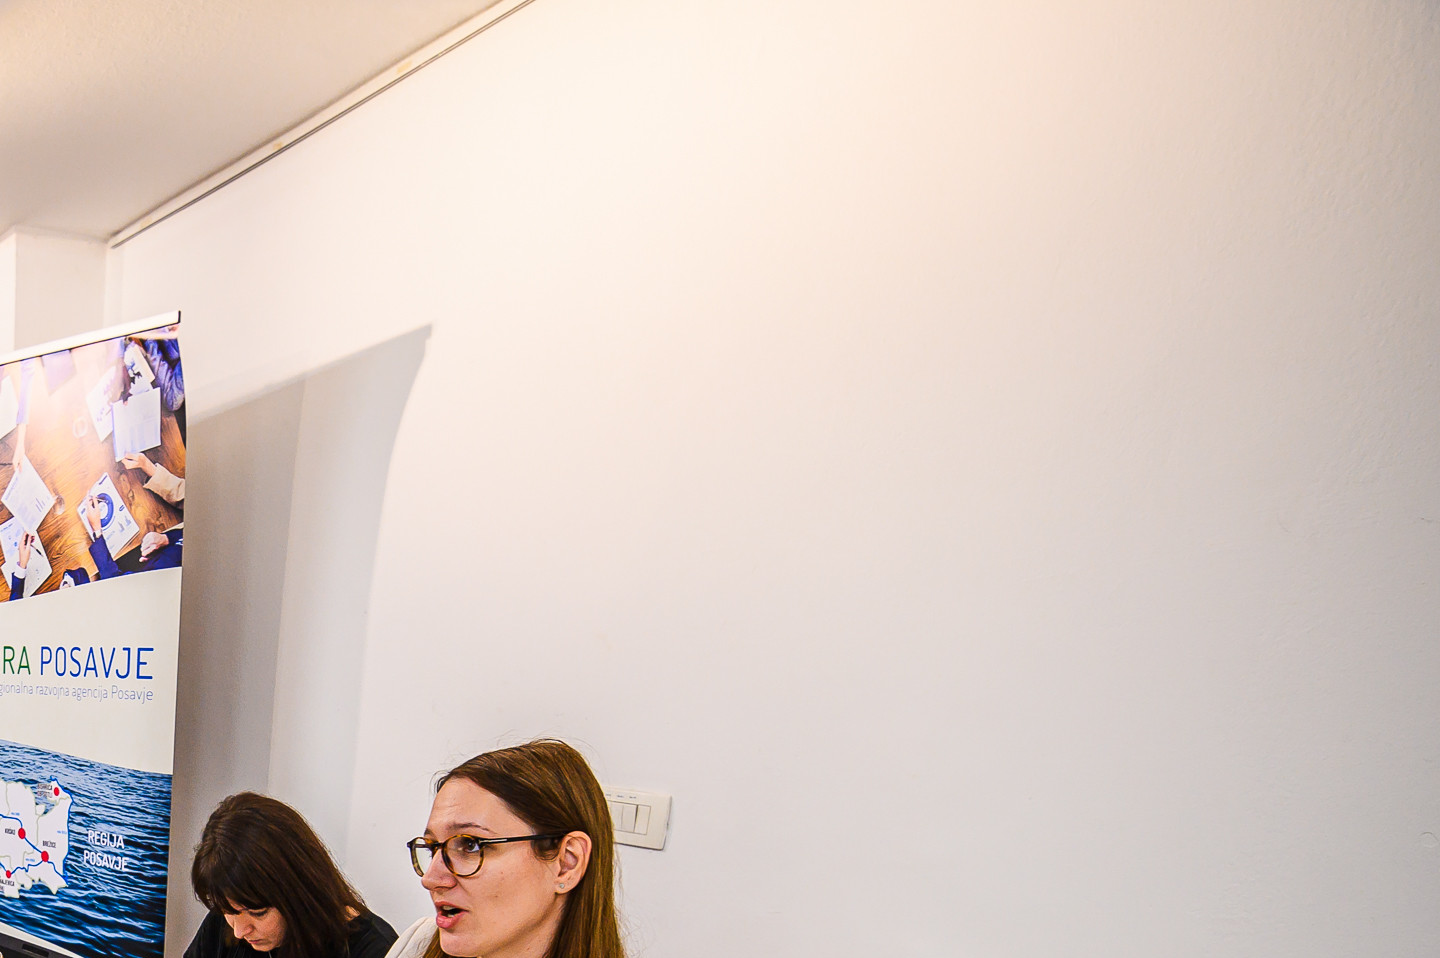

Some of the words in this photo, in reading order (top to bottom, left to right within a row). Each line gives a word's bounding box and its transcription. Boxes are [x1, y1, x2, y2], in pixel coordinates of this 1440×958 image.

[40, 646, 154, 680] POSAVJE
[35, 685, 70, 699] razvojna
[71, 685, 108, 702] agencija
[111, 685, 154, 704] Posavje
[88, 830, 125, 849] REGIJA
[83, 850, 129, 871] POSAVJE
